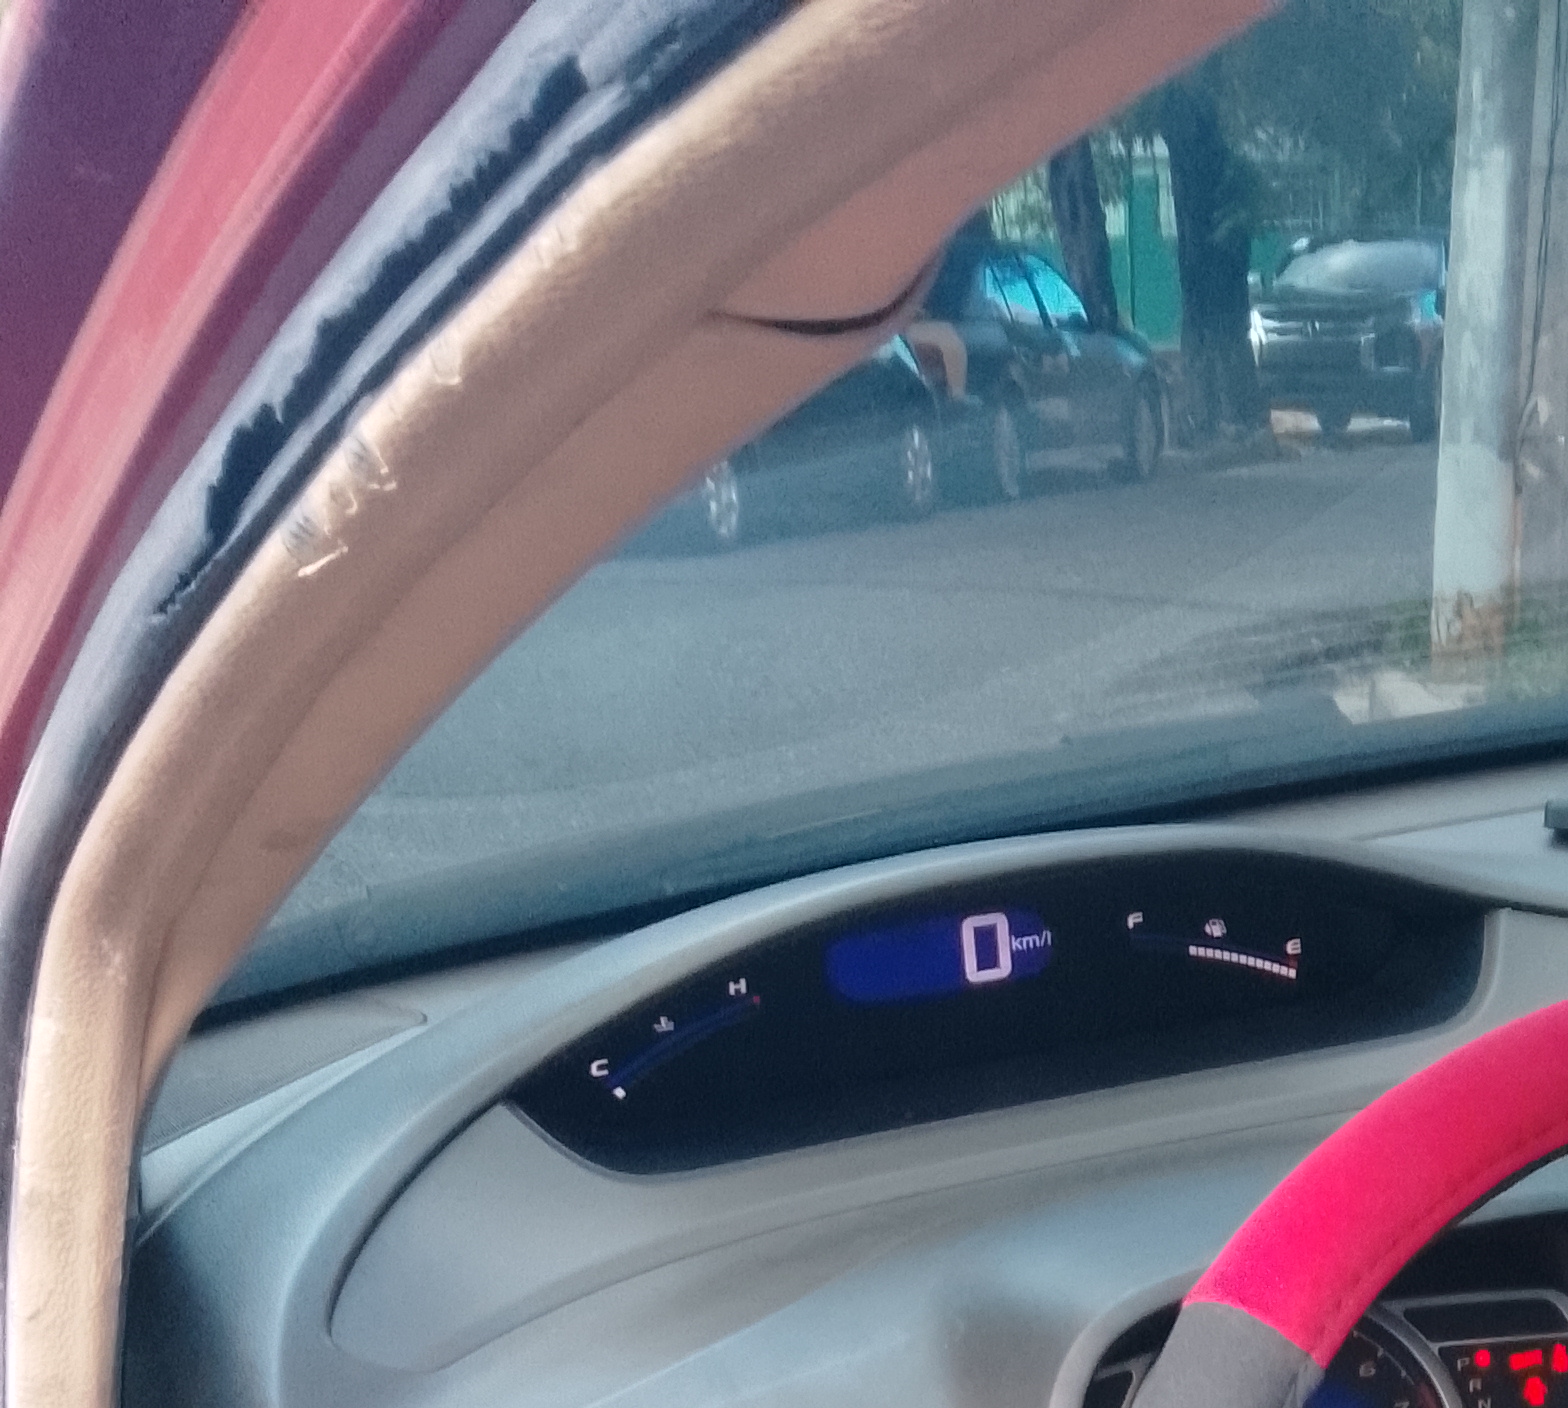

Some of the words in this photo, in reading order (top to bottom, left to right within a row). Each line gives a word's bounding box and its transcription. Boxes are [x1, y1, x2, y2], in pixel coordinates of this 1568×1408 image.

[1127, 910, 1144, 929] F
[962, 911, 1012, 983] 0
[1286, 938, 1301, 955] E
[728, 977, 747, 996] H
[589, 1058, 609, 1078] C
[1456, 1356, 1470, 1372] P
